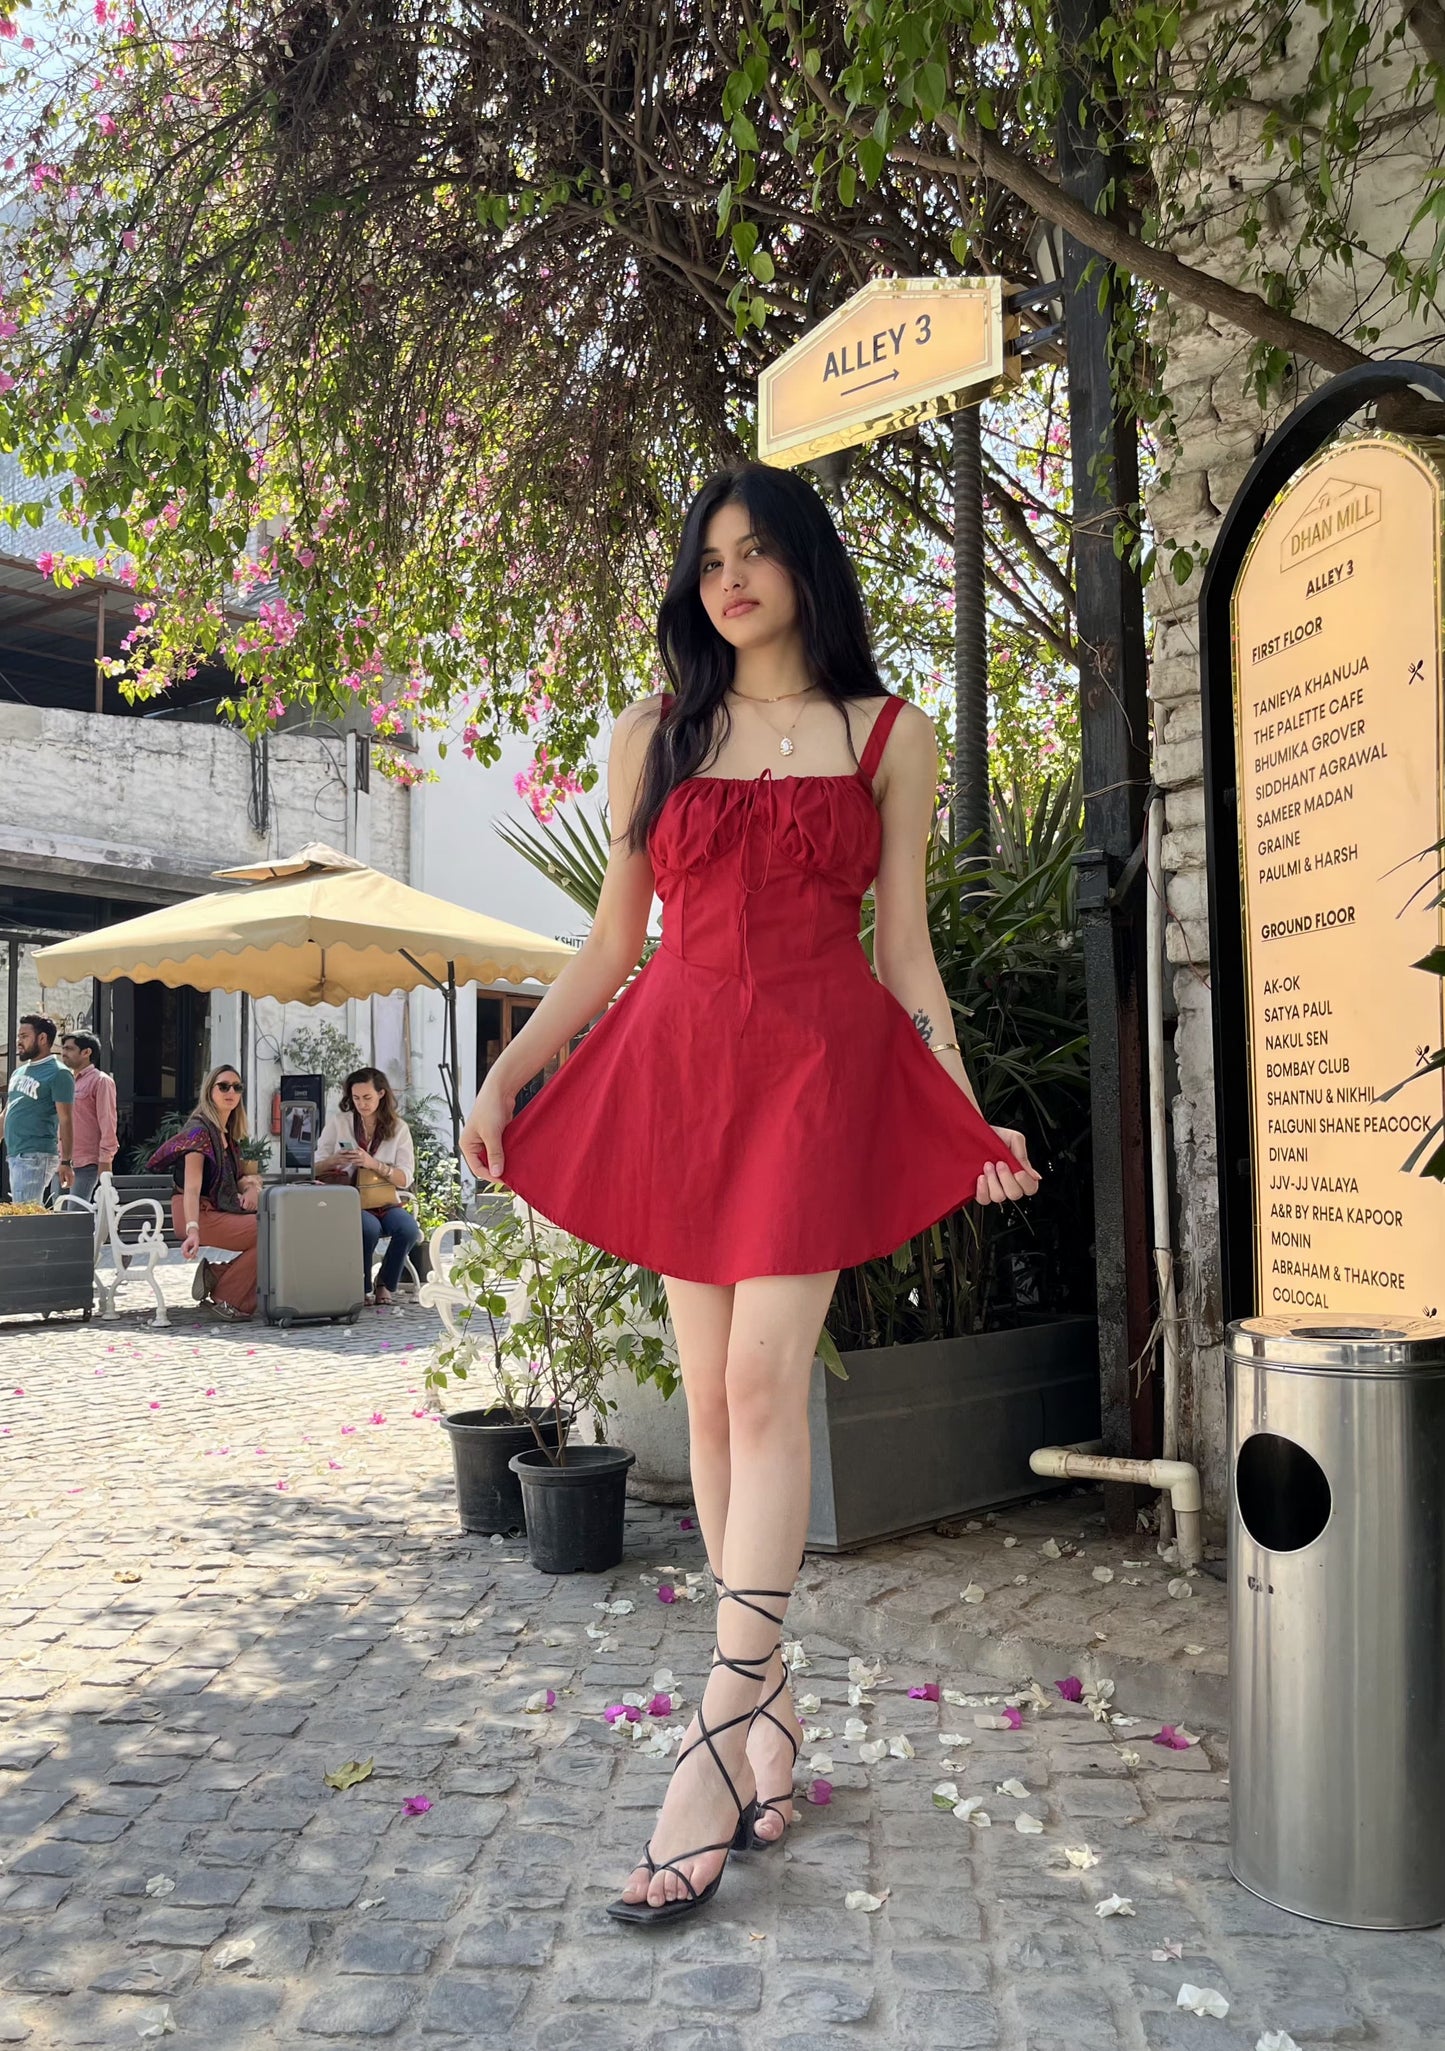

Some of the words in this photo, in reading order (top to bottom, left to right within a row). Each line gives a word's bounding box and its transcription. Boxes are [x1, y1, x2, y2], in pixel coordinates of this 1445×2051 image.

[823, 323, 907, 383] ALLEY
[915, 314, 932, 345] 3
[1291, 518, 1332, 556] DHAN
[1337, 495, 1374, 532] MILL
[1306, 566, 1345, 597] ALLEY
[1346, 560, 1354, 576] 3
[1253, 636, 1281, 662] FIRST
[1284, 616, 1322, 646] FLOOR
[1253, 685, 1302, 717] TANIEYA
[1305, 656, 1369, 696] KHANUJA
[1254, 727, 1275, 745] THE
[1277, 703, 1326, 736] PALETTE
[1329, 688, 1364, 716] CAFE
[1255, 740, 1309, 773] BHUMIKA
[1312, 719, 1365, 751] GROVER
[1256, 767, 1316, 800] SIDDHANT
[1319, 743, 1387, 780] AGRAWAL
[1256, 802, 1301, 828] SAMEER
[1304, 784, 1353, 814] MADAN
[1258, 830, 1301, 856] GRAINE
[1259, 858, 1301, 884] PAULMI
[1304, 858, 1312, 872] &
[1314, 844, 1358, 870] HARSH
[1261, 916, 1312, 939] GROUND
[1316, 906, 1355, 929] FLOOR
[1264, 975, 1300, 995] AK-OK
[1264, 1004, 1299, 1023] SATYA
[1303, 1000, 1333, 1018] PAUL
[1266, 1033, 1304, 1050] NAKUL
[1307, 1030, 1328, 1045] SEN
[1267, 1061, 1315, 1078] BOMBAY
[1318, 1058, 1350, 1075] CLUB
[1267, 1089, 1323, 1106] SHANTNU
[1326, 1089, 1334, 1103] &
[1336, 1087, 1377, 1103] NIKHIL
[1268, 1118, 1316, 1134] FALGUNI
[1320, 1118, 1360, 1133] SHANE
[1364, 1116, 1432, 1133] PEACOCK
[1270, 1147, 1308, 1162] DIVANI
[1270, 1176, 1308, 1191] JJV-JJ
[1311, 1177, 1359, 1193] VALAYA
[1271, 1203, 1292, 1218] A&R
[1296, 1205, 1309, 1219] BY
[1312, 1206, 1344, 1223] RHEA
[1347, 1209, 1403, 1226] KAPOOR
[1271, 1232, 1311, 1248] MONIN
[1272, 1259, 1330, 1280] ABRAHAM
[1334, 1266, 1341, 1281] &
[1344, 1267, 1405, 1290] THAKORE
[1273, 1287, 1329, 1309] COLOCAL
